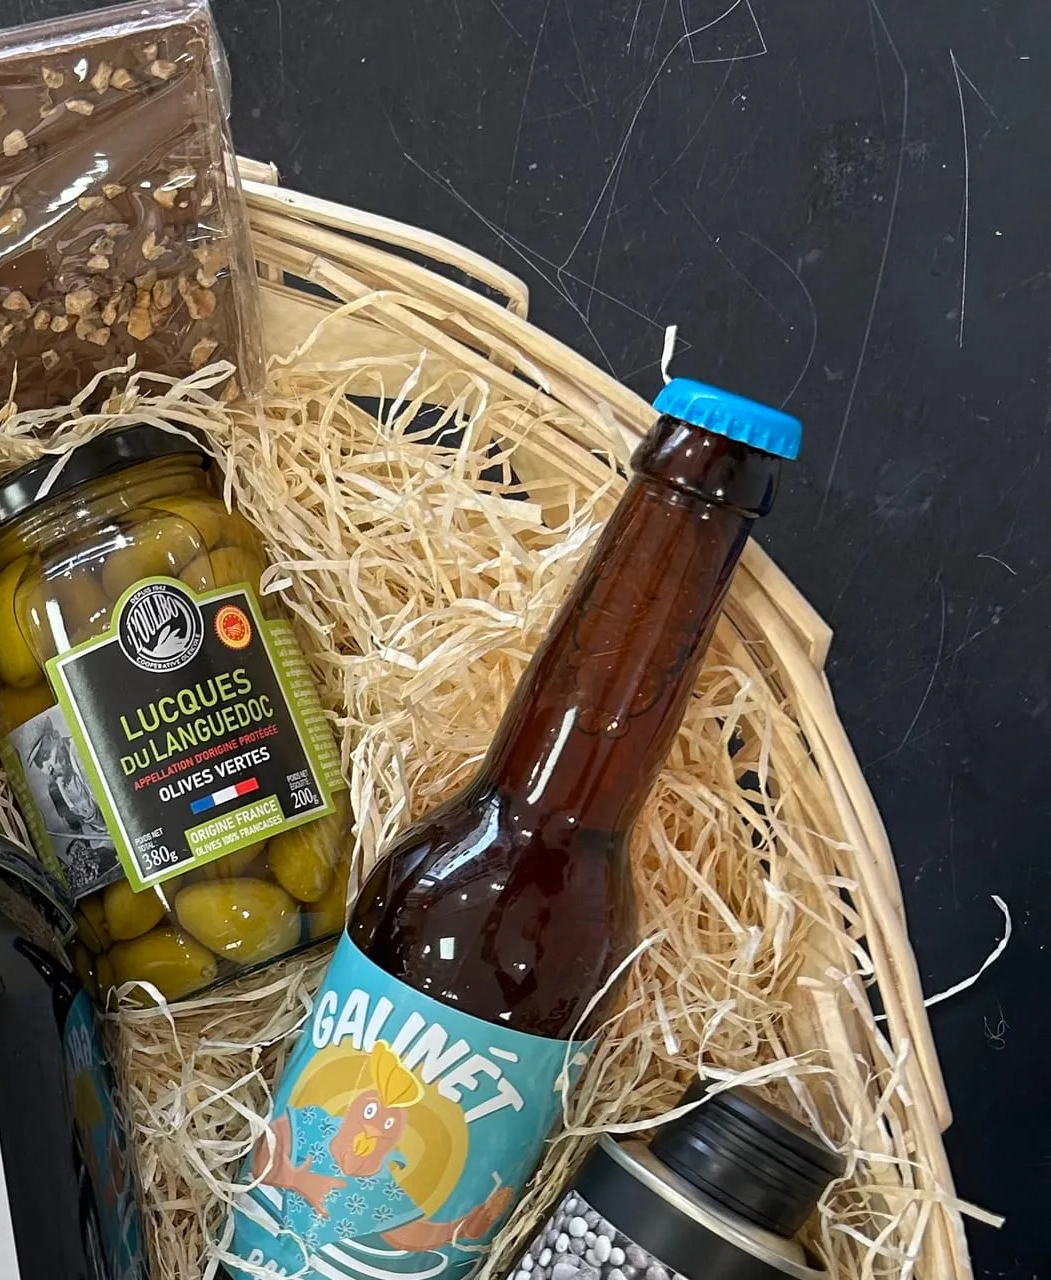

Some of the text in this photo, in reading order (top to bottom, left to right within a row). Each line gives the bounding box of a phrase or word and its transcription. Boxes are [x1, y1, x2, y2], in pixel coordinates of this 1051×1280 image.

[120, 668, 252, 741] LUCQUES
[120, 695, 274, 776] DU LANGUEDOC
[134, 724, 279, 791] APPELLATION D'ORIGINE PROTÉGÉE
[159, 746, 271, 802] OLIVES VERTES
[190, 799, 278, 844] ORIGINE FRANCE
[195, 832, 240, 856] OLIVES 100%
[142, 845, 178, 870] 380g
[312, 988, 525, 1123] GALINÉT
